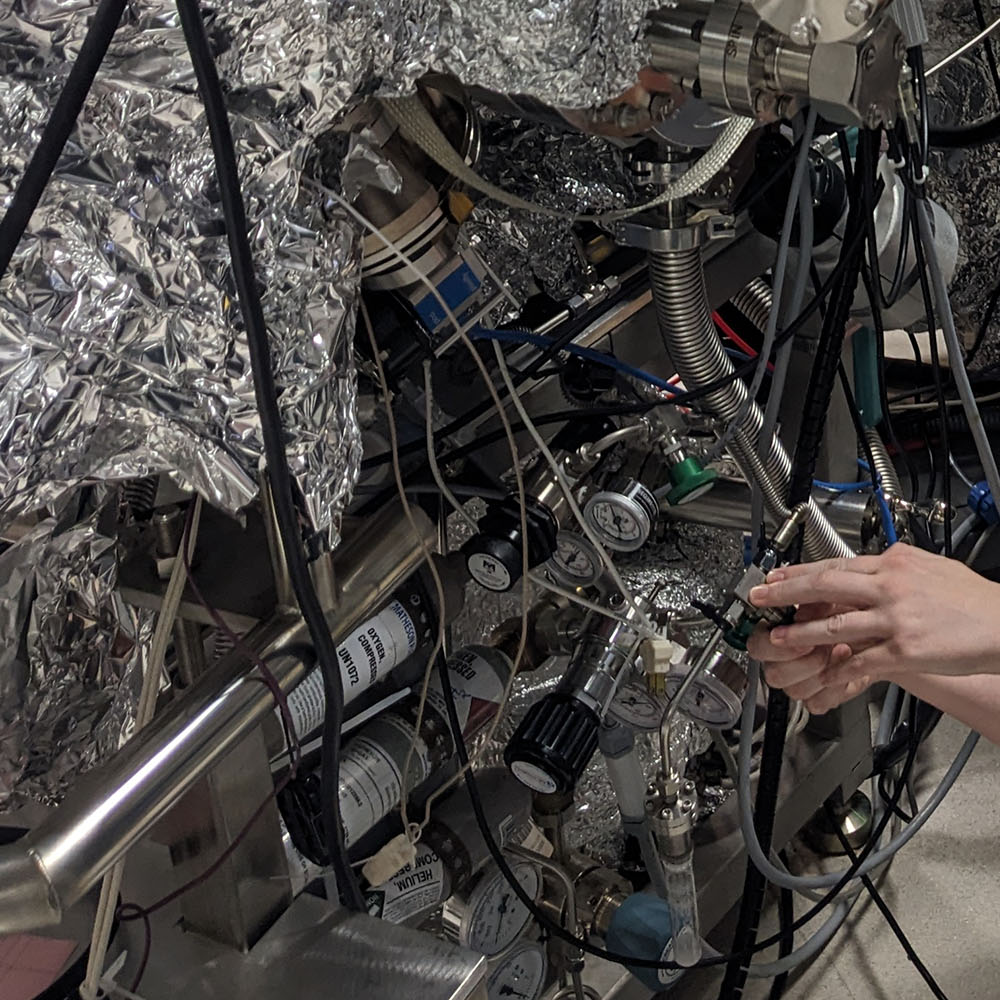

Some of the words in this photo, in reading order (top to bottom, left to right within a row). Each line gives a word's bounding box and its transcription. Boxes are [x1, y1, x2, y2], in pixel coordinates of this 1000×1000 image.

[367, 627, 386, 664] OXYGEN,
[338, 647, 360, 687] UN1072
[393, 868, 433, 891] HELIUM,
